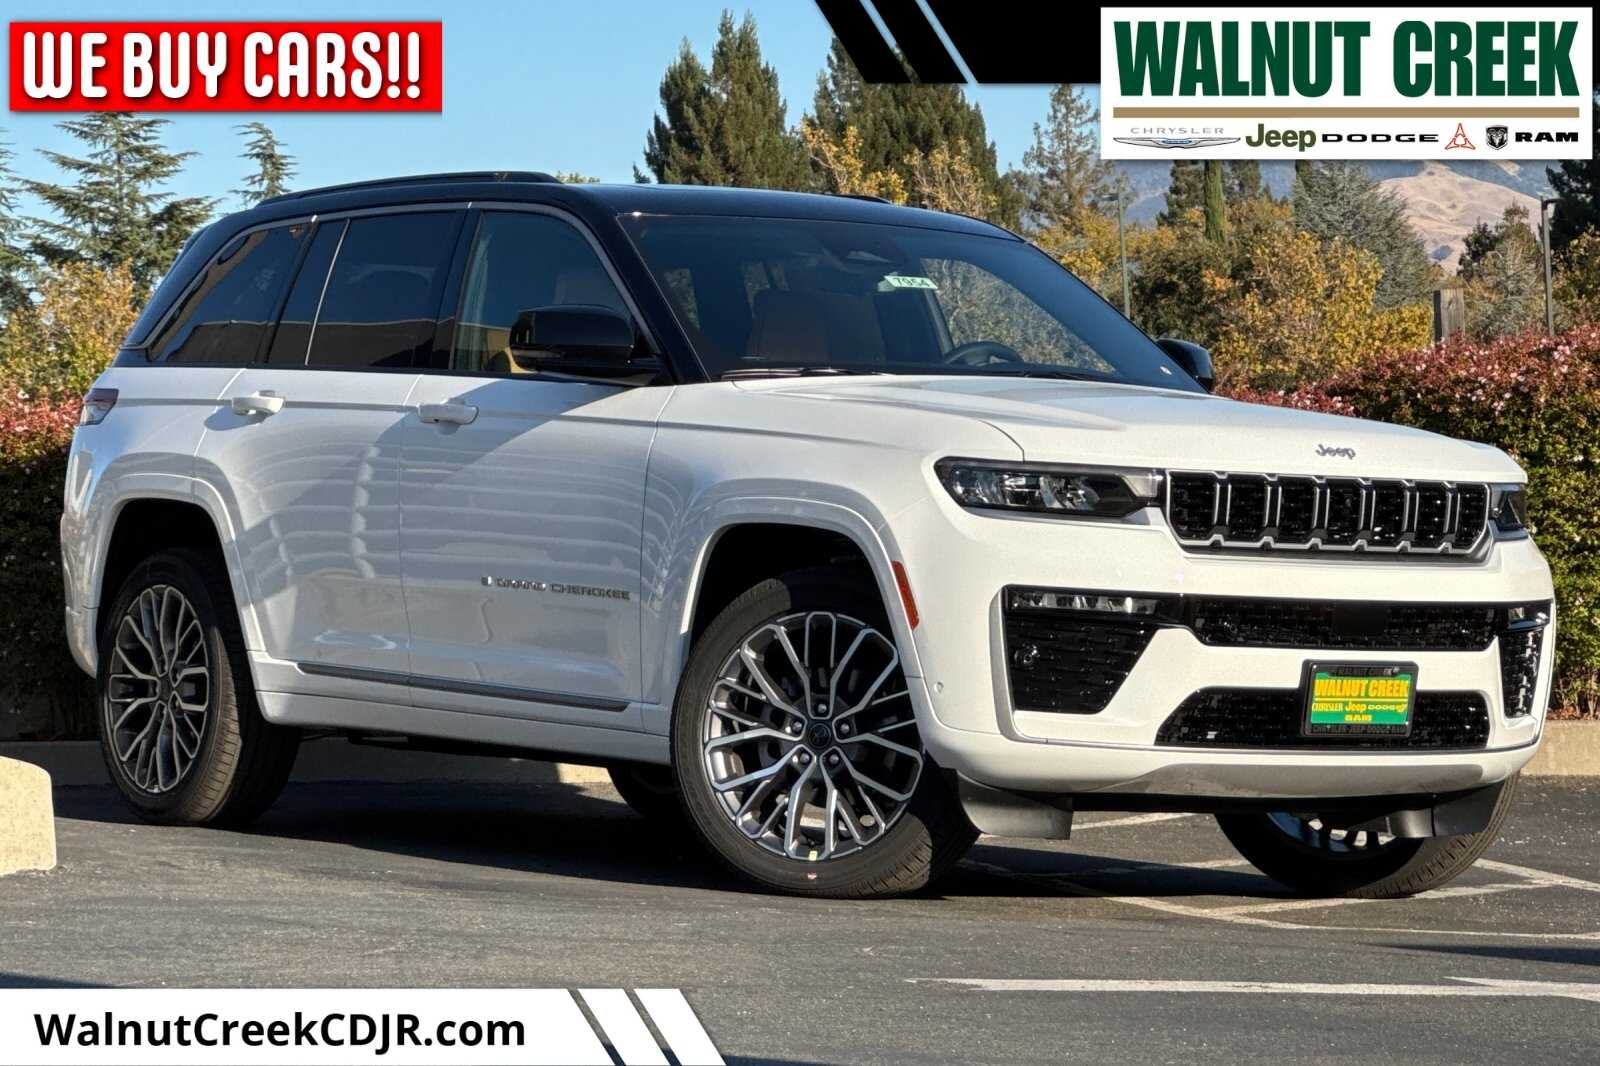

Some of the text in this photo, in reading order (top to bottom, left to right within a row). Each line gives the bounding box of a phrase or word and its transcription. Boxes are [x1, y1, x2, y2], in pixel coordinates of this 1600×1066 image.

[1315, 443, 1356, 460] Jeep
[496, 578, 631, 600] GRAND CHEROKEE
[1314, 680, 1409, 697] WALNUT CREEK
[1345, 701, 1367, 713] Jeep
